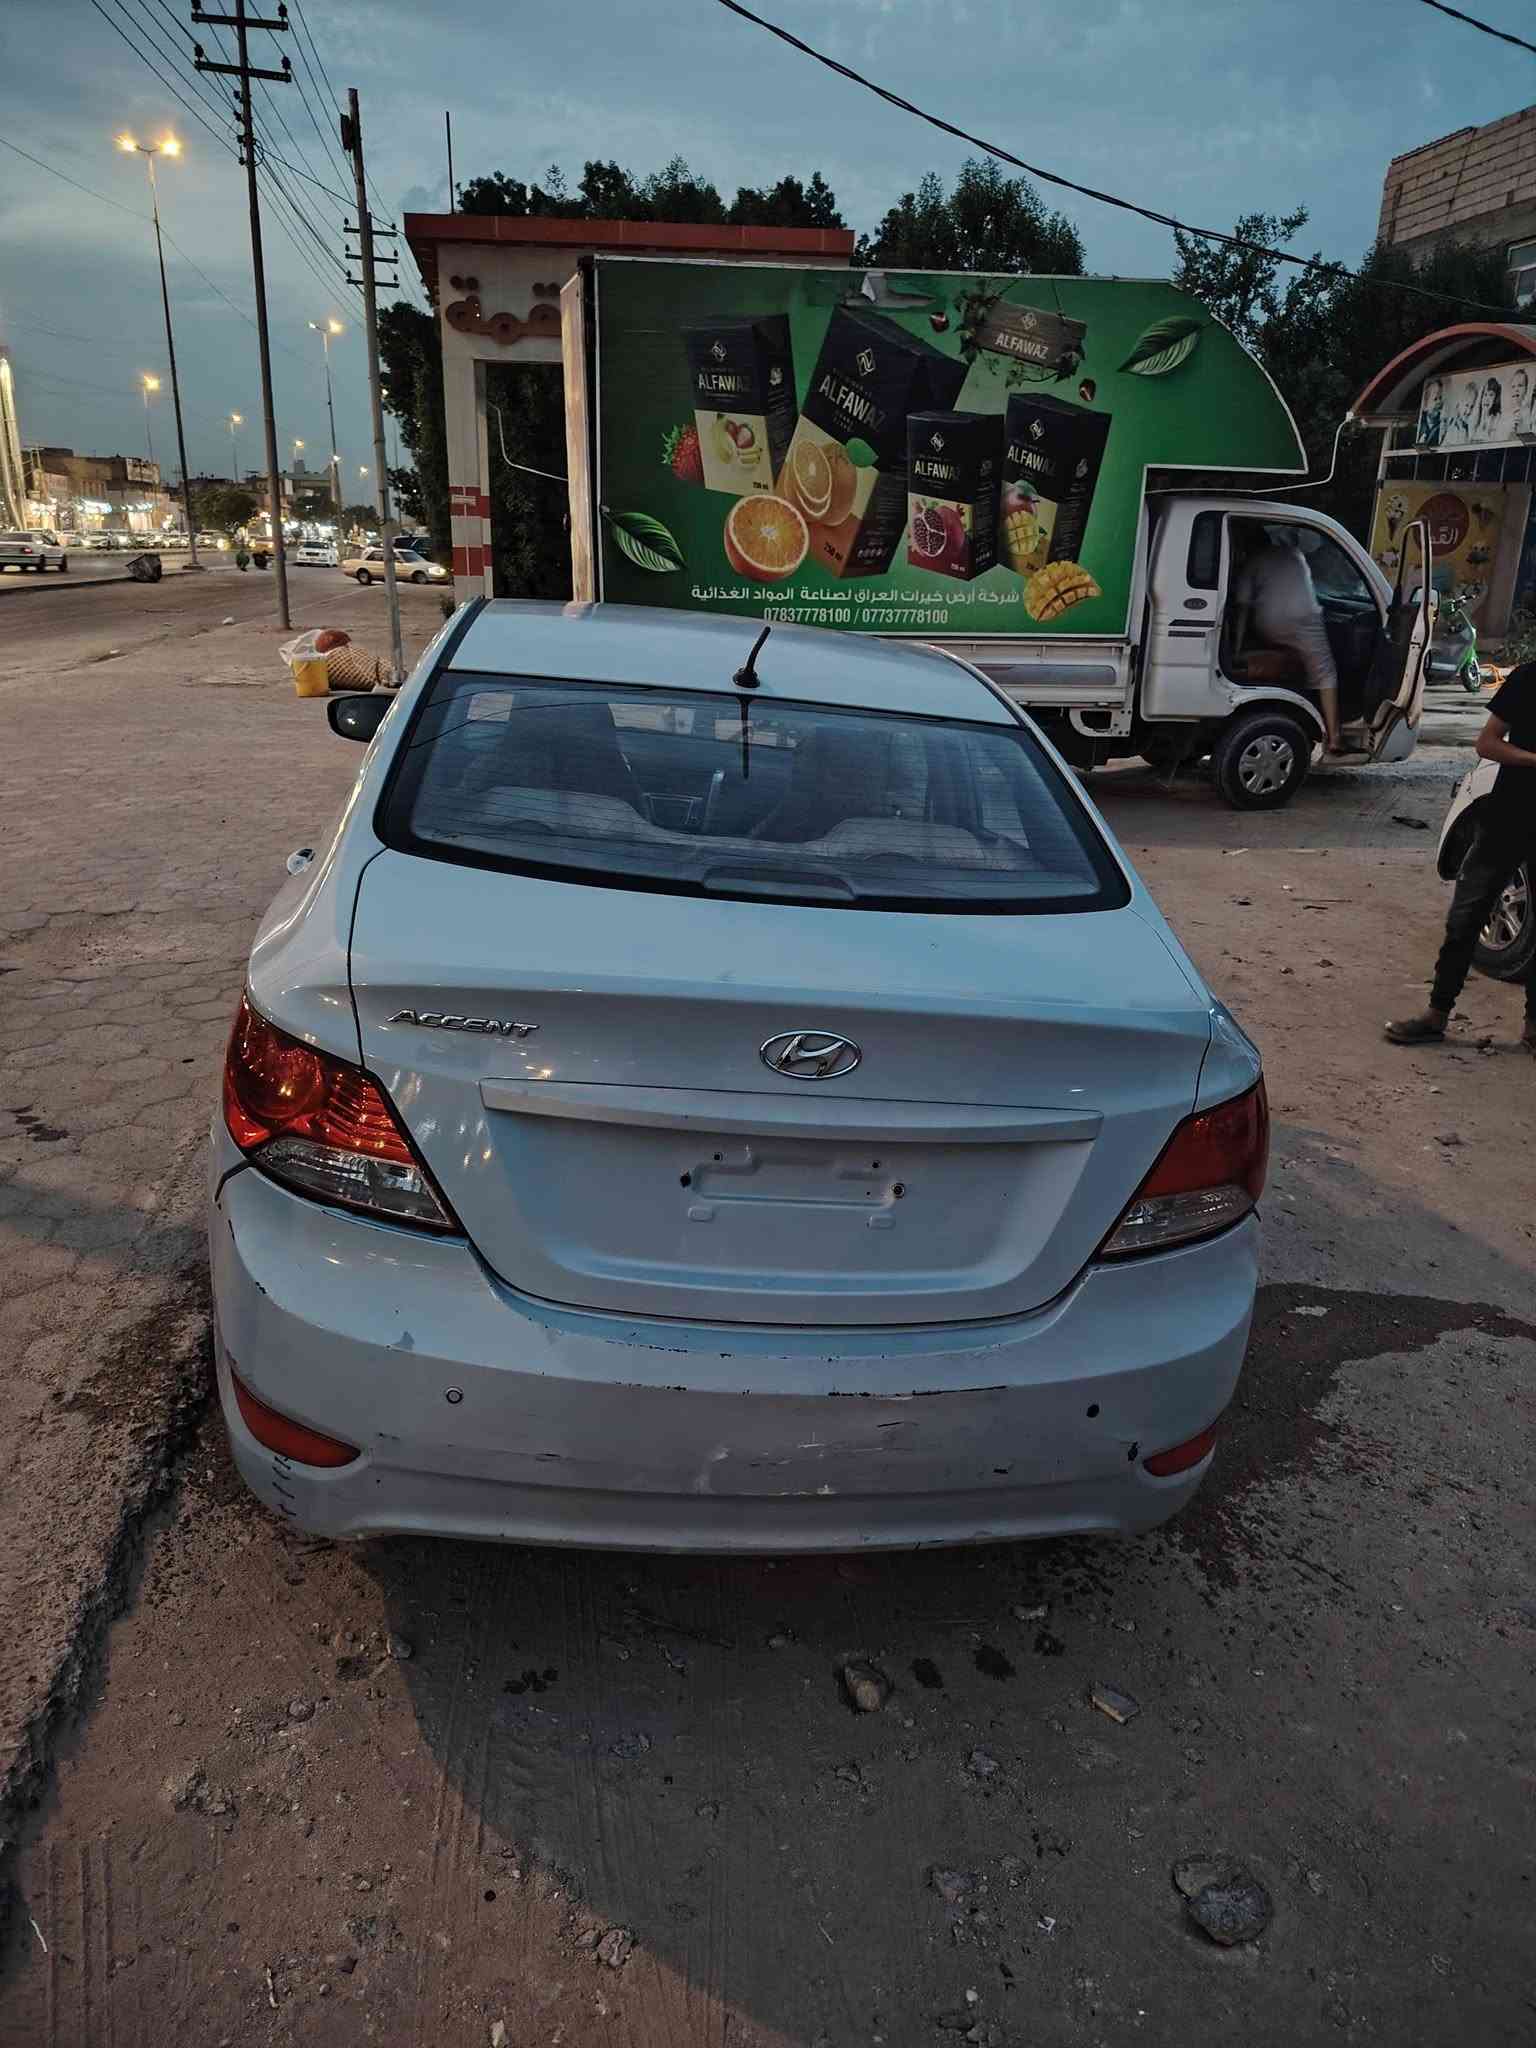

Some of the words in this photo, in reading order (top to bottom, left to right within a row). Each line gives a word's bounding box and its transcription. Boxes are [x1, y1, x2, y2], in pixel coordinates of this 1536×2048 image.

[994, 332, 1049, 360] ALFAWAZ
[697, 372, 752, 393] ALFAWA
[913, 459, 961, 481] ALFAWA
[690, 585, 750, 601] الغذائية
[752, 586, 795, 602] المواد
[799, 585, 852, 601] لصناعة
[854, 588, 898, 604] العراق
[900, 588, 943, 604] خيرات
[978, 587, 1020, 605] شركة
[763, 607, 851, 623] 07837778100
[861, 608, 949, 624] 07737778100
[385, 1008, 541, 1038] ACCENT
